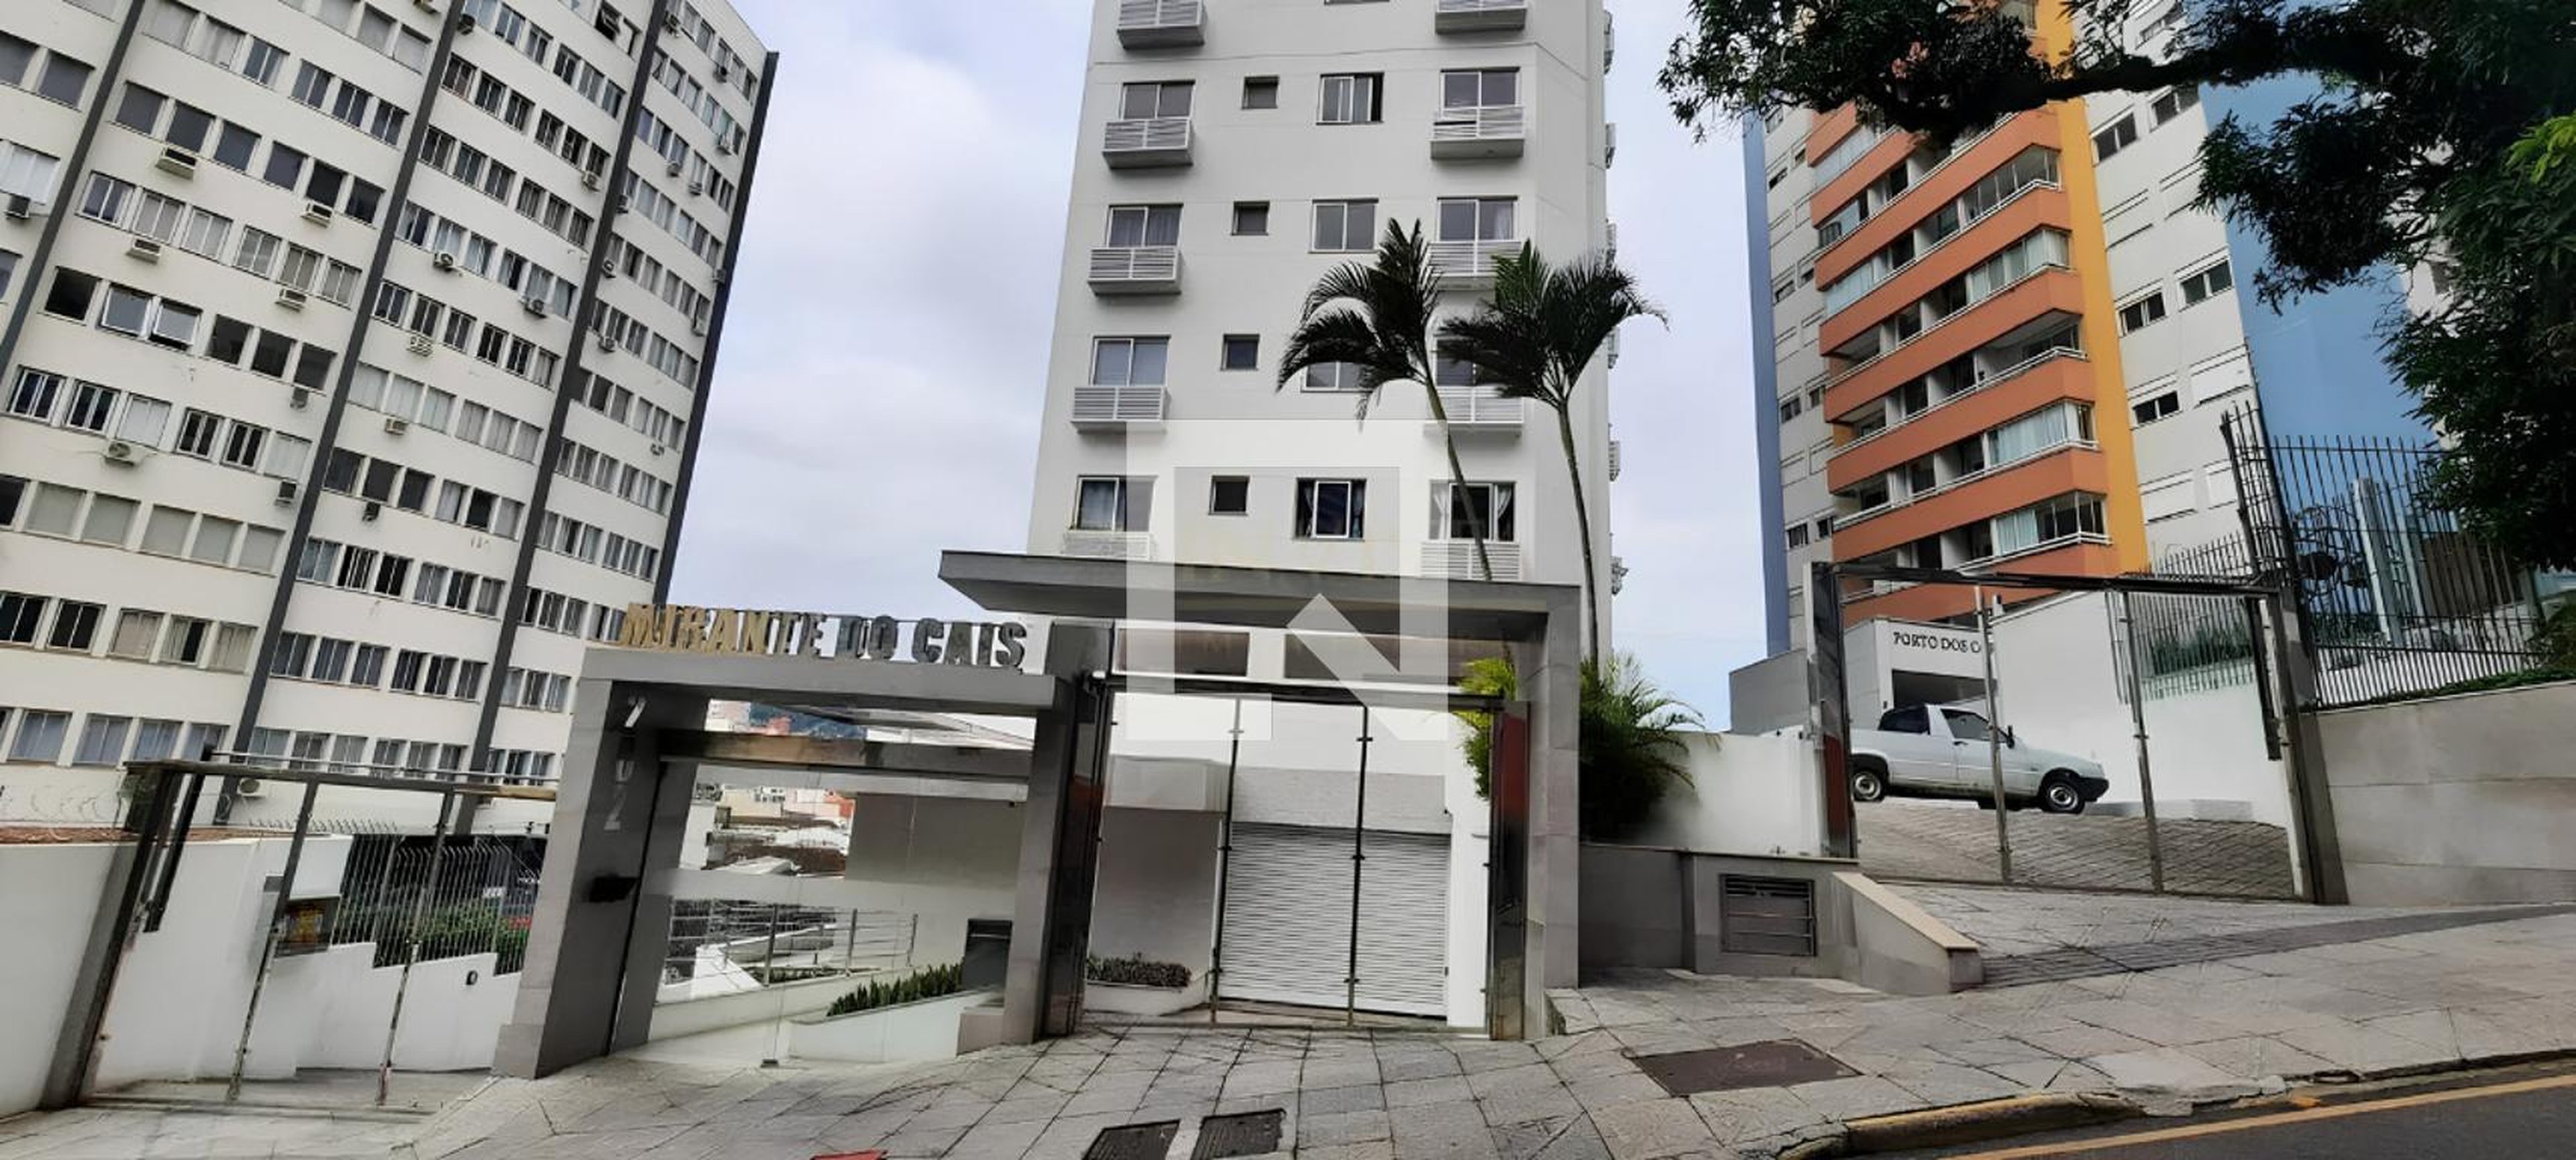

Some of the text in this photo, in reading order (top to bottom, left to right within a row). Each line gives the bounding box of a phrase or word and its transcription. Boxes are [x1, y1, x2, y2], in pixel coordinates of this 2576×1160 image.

[619, 603, 1026, 668] MIRANTE DO CAIS
[1893, 632, 1937, 649] PORTO
[1941, 637, 1968, 653] DOS
